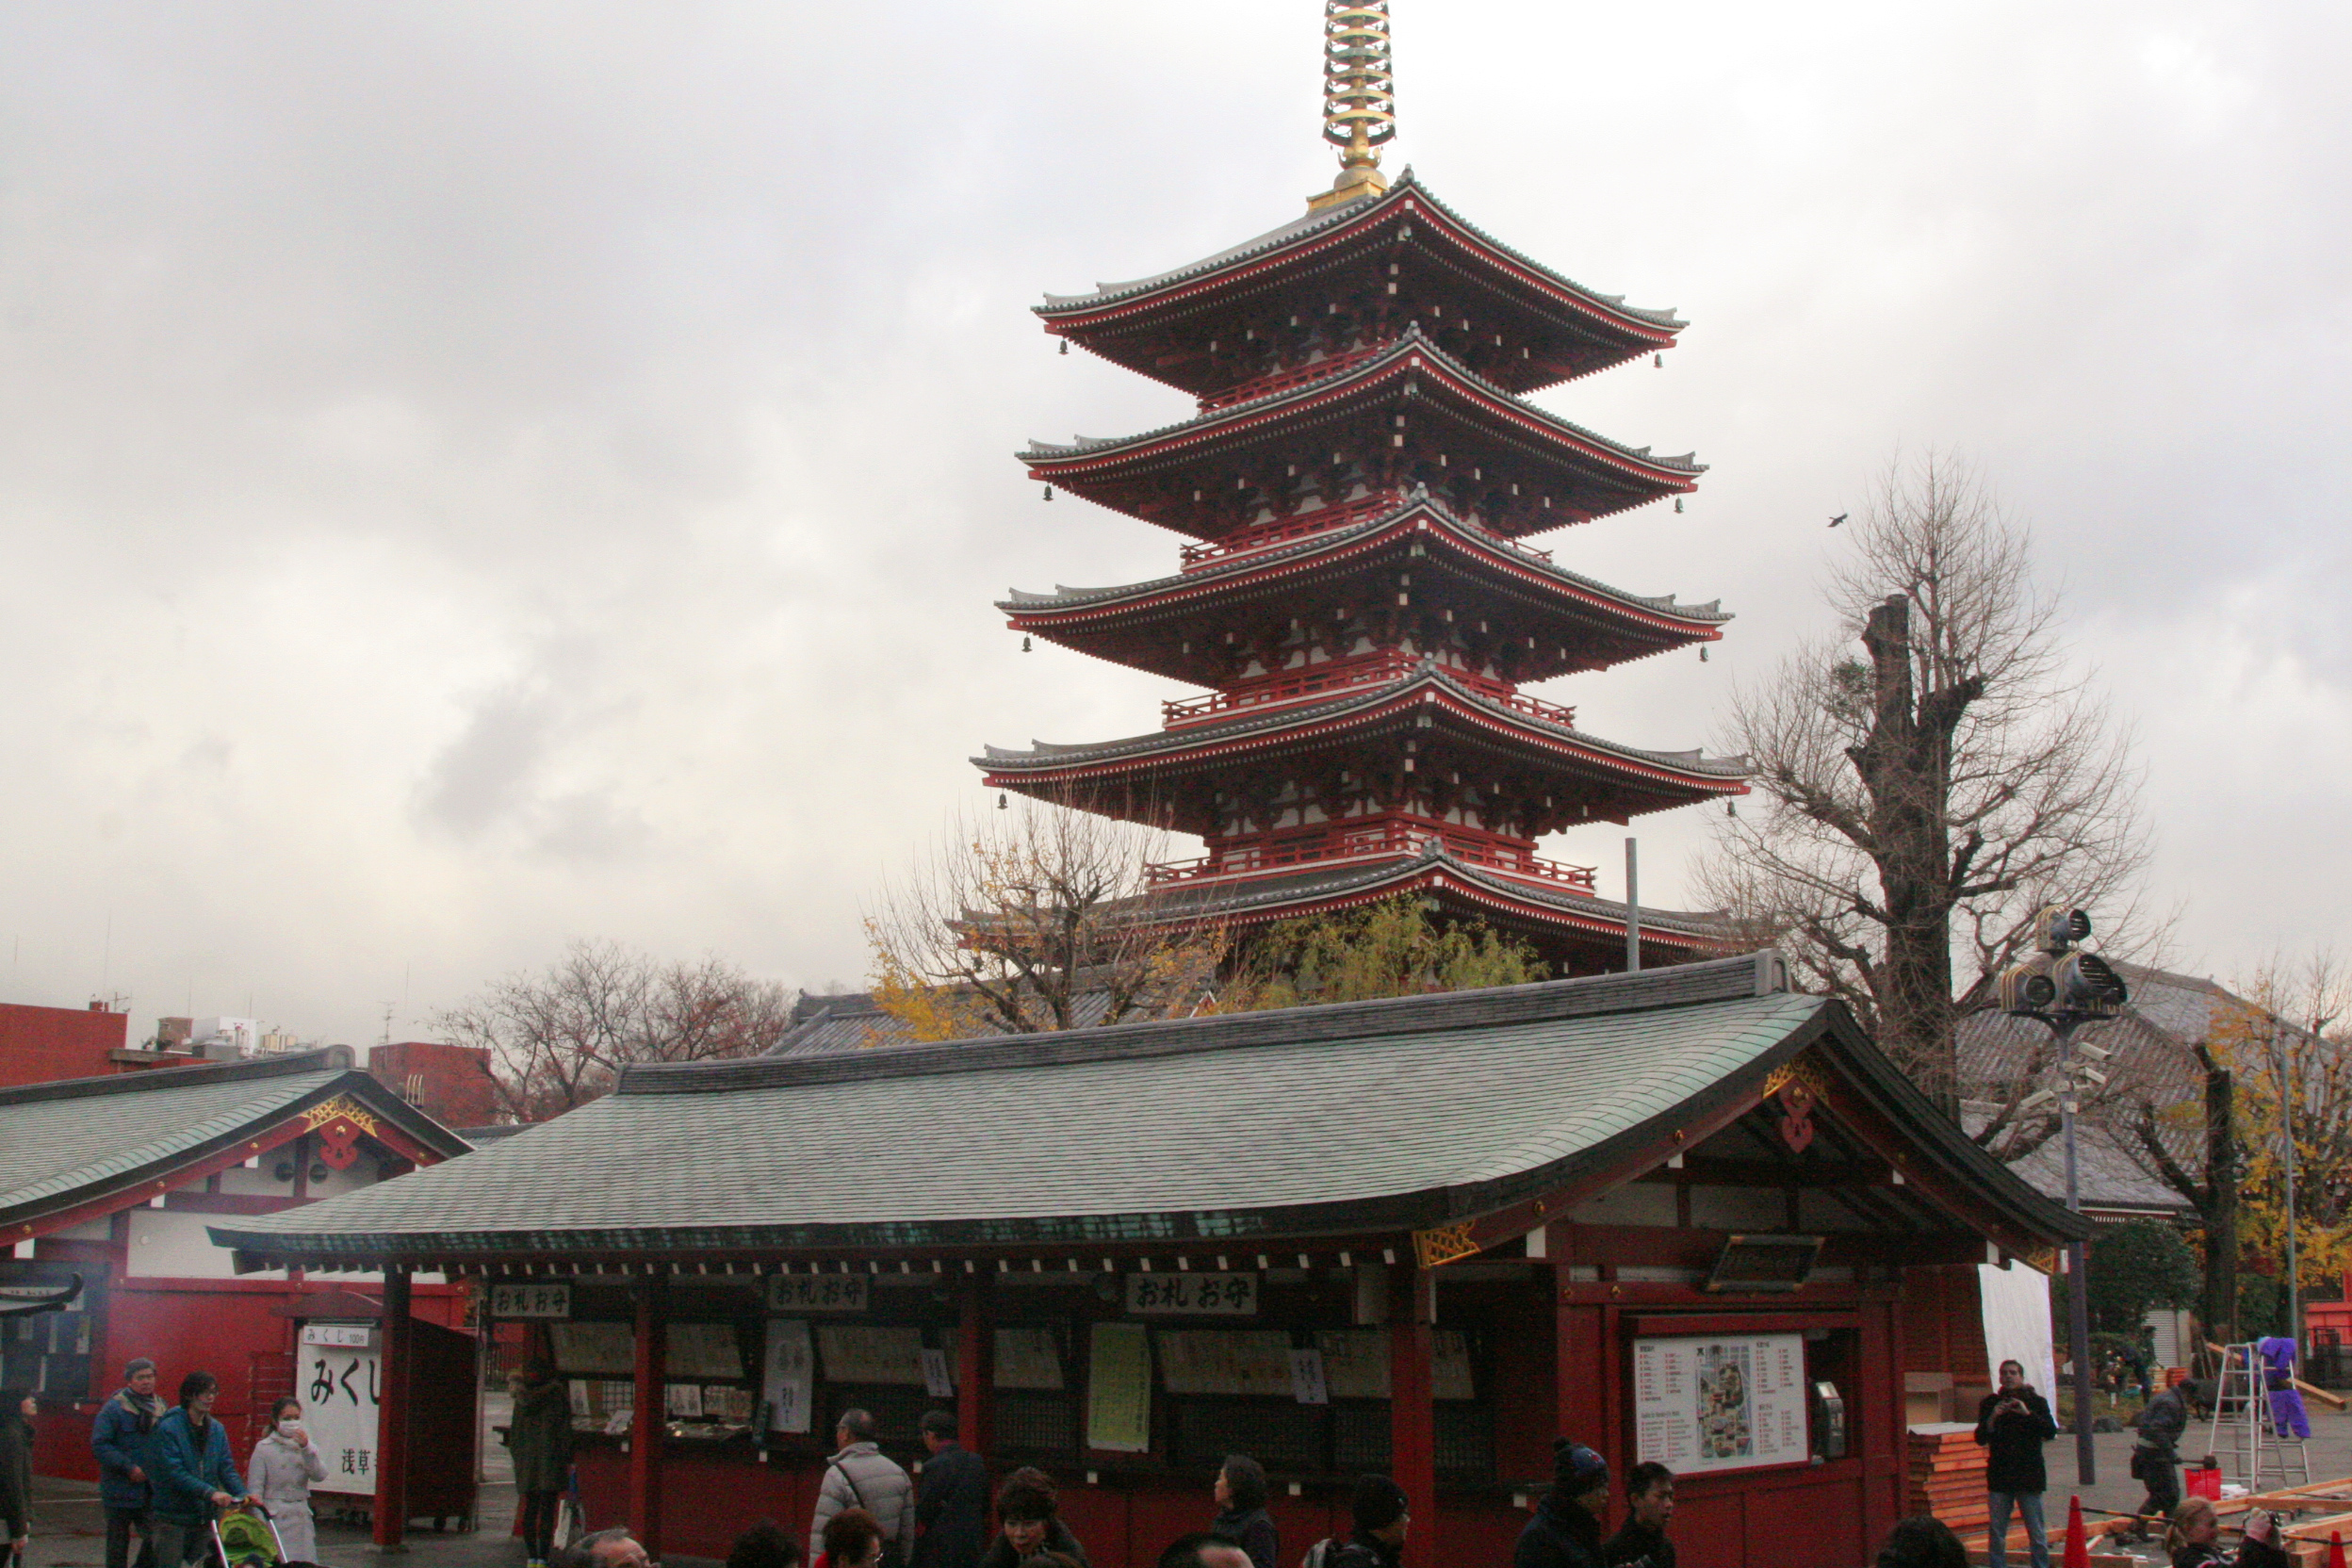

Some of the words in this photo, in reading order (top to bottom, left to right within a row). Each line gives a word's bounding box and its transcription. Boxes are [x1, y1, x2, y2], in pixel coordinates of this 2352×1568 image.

[496, 1288, 566, 1313] お札お守
[1135, 1277, 1251, 1309] お札お守
[306, 1329, 344, 1343] みくじ
[341, 1448, 378, 1475] 浅草
